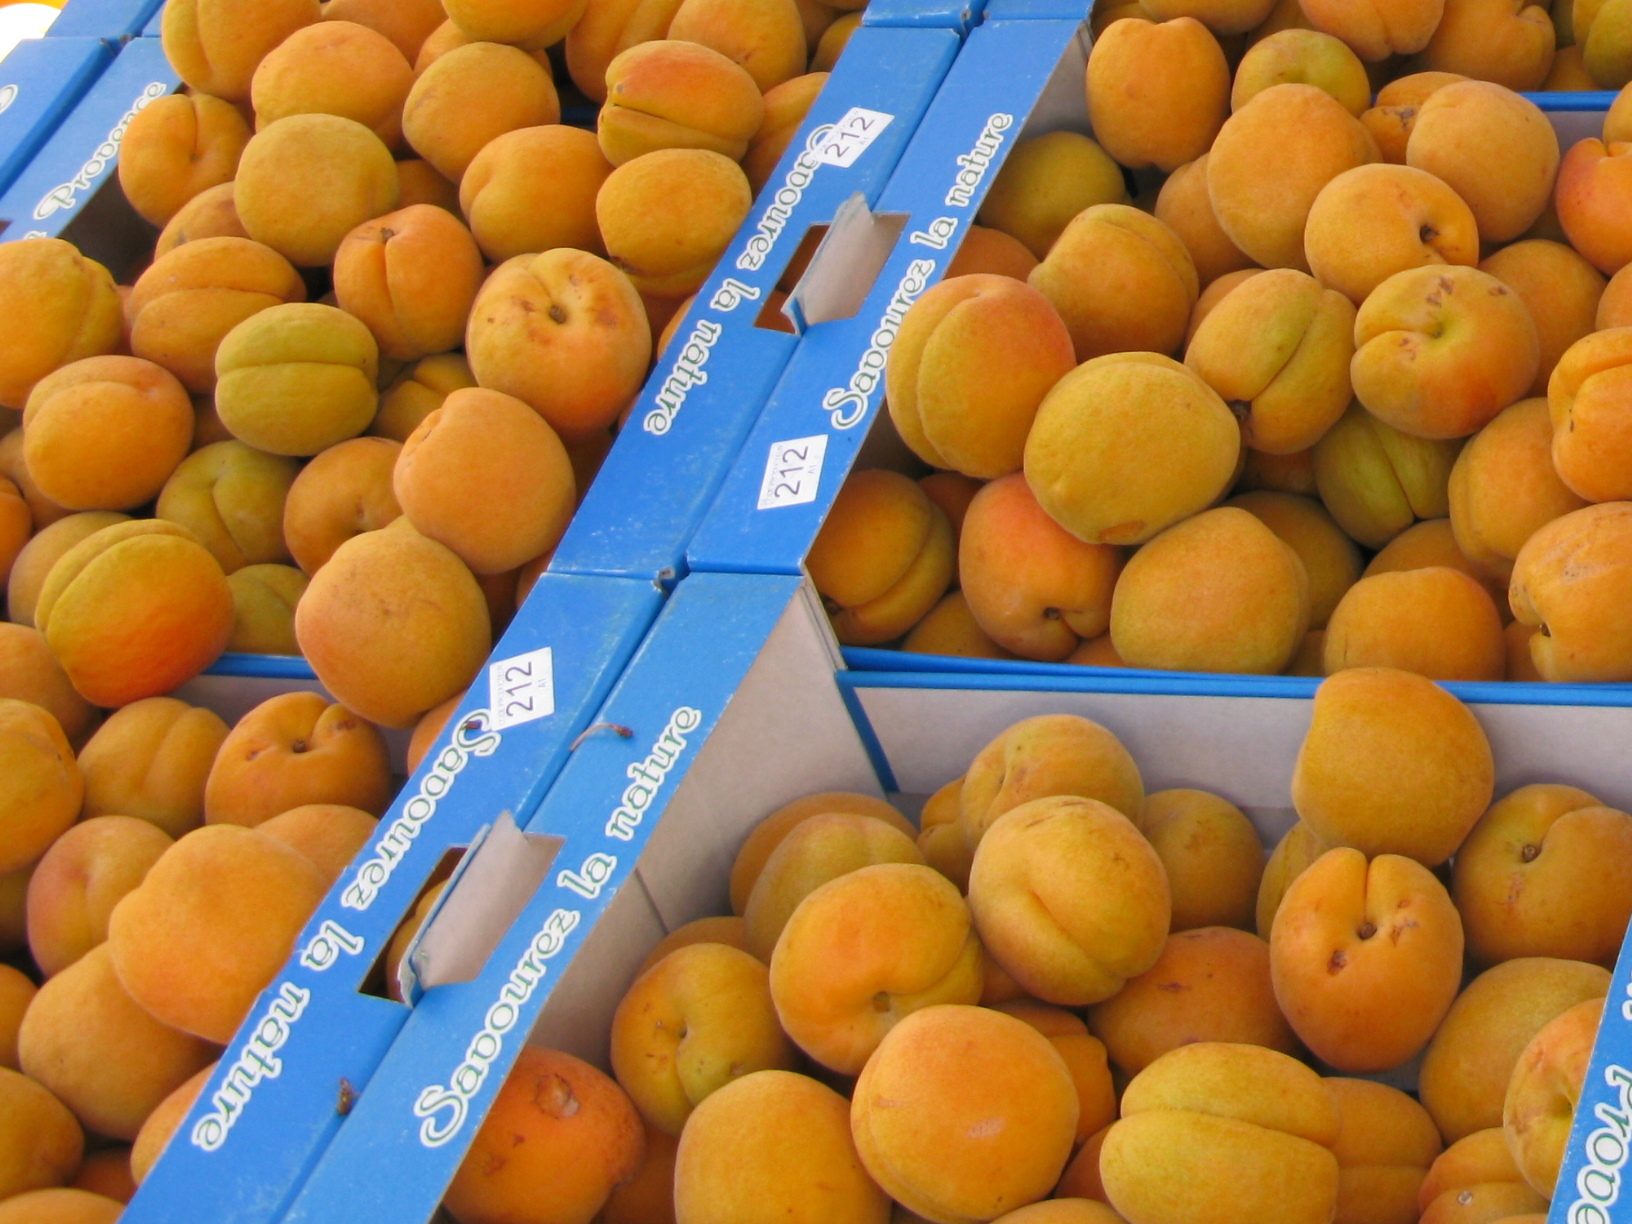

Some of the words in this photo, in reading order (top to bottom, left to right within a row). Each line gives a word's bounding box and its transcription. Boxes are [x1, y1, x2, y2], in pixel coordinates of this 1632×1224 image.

[824, 117, 875, 158] 212
[711, 278, 760, 312] la
[823, 259, 936, 429] Savourez
[911, 217, 957, 250] la
[945, 112, 1013, 207] nature
[643, 319, 722, 436] nature
[774, 445, 809, 497] 212
[505, 661, 534, 717] 212
[341, 708, 502, 911] Savourez
[301, 919, 364, 971] la
[414, 908, 580, 1147] Savourez
[556, 852, 617, 899] la
[606, 706, 701, 840] nature
[192, 982, 310, 1151] nature
